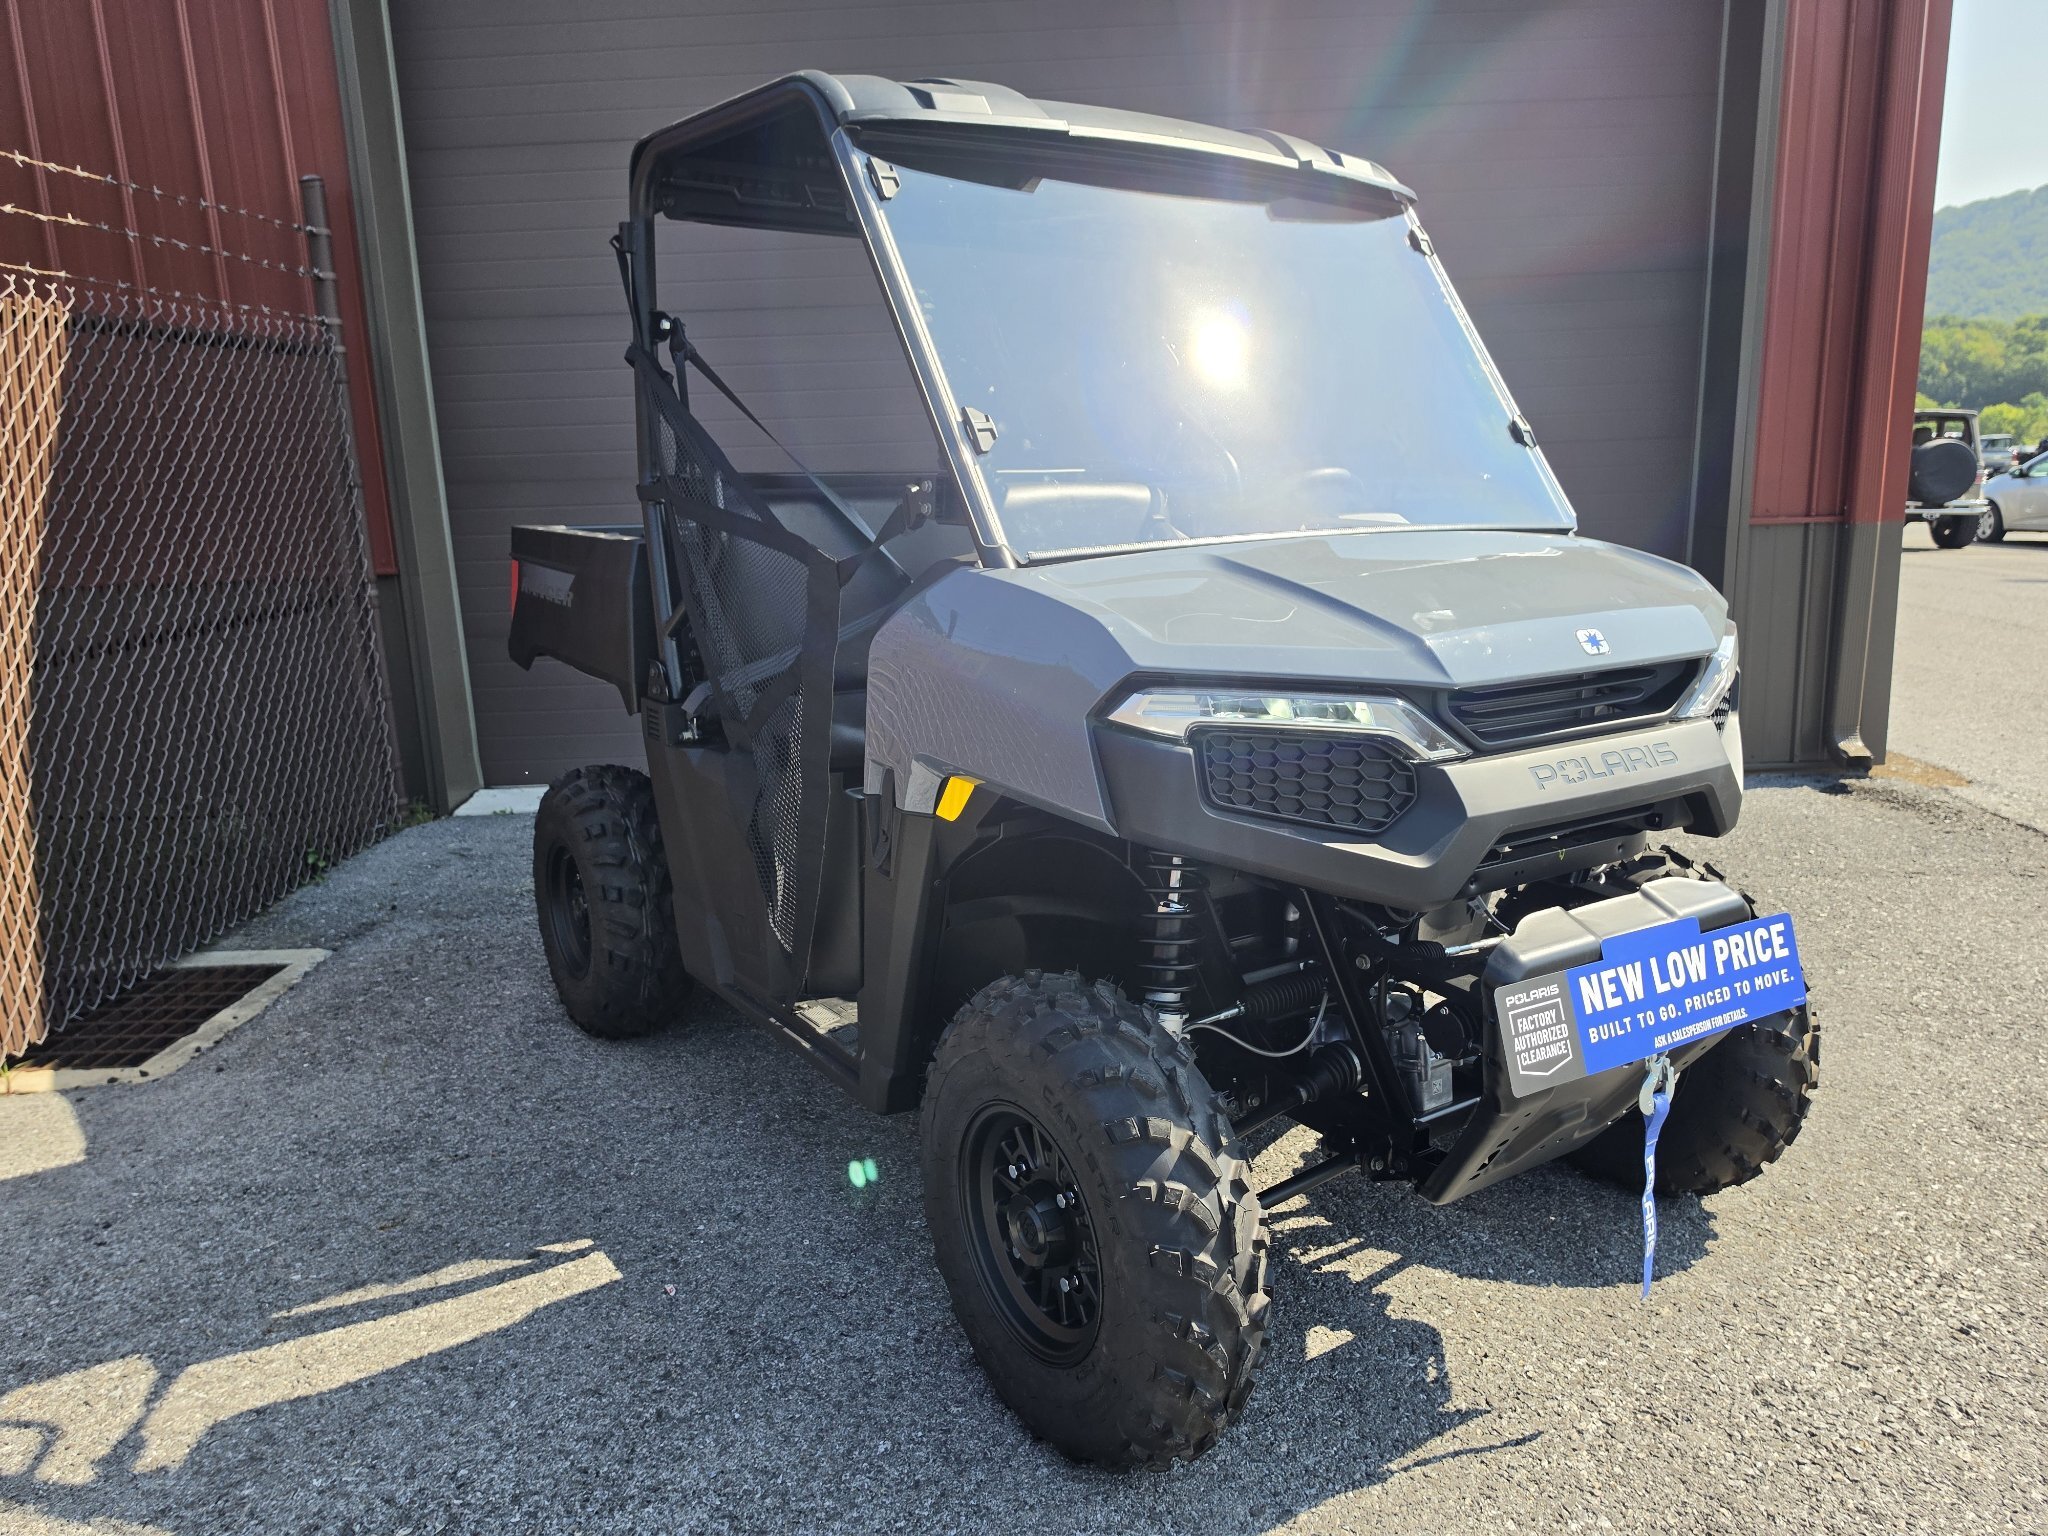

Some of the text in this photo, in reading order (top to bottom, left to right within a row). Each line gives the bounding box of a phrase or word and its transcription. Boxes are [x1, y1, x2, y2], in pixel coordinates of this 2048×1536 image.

[1528, 741, 1679, 791] POLARIS
[1578, 922, 1790, 1015] NEW LOW PRICE
[1505, 983, 1560, 1008] POLARIS
[1588, 968, 1795, 1044] BUILT TO GO. PRICED TO MOVE.
[1514, 1023, 1569, 1053] AUTHORIZED
[1516, 1009, 1557, 1034] FACTORY
[1654, 1007, 1749, 1049] ASK A SALESPERSON FOR DETAILS.
[1520, 1040, 1568, 1066] CLEARANCE
[1643, 1155, 1655, 1258] POLARIS
